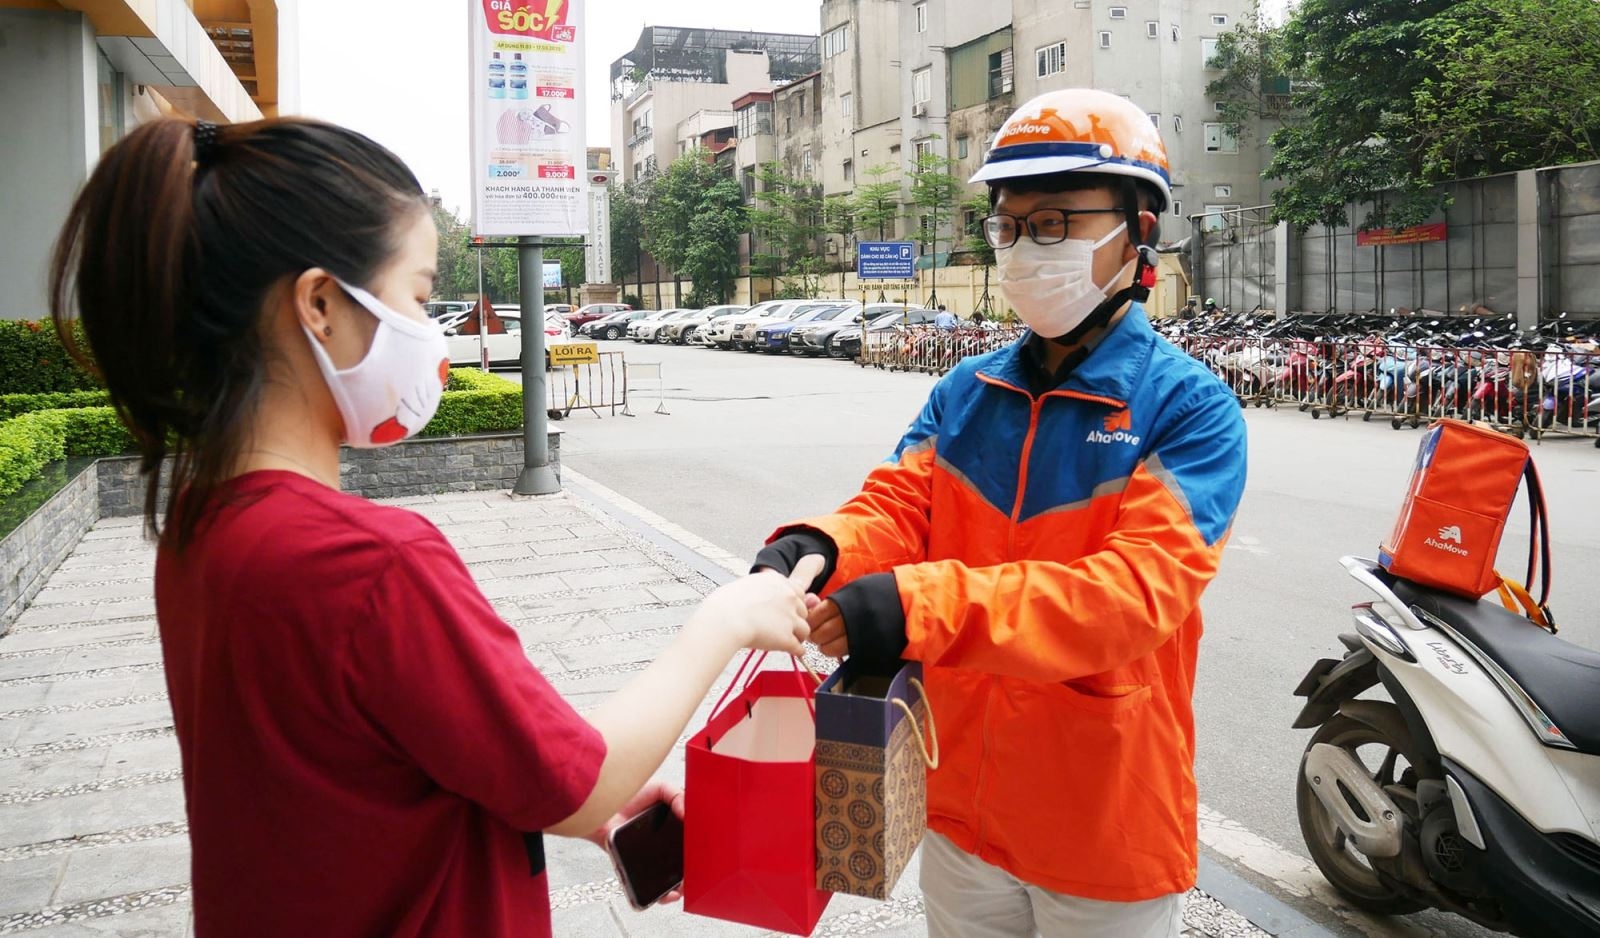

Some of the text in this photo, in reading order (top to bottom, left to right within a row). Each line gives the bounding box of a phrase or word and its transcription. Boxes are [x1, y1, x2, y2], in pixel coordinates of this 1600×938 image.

[490, 0, 512, 11] GIÁ
[497, 5, 544, 32] SỐC
[1002, 123, 1051, 137] haMove
[902, 248, 909, 257] P
[577, 347, 593, 355] RA
[1086, 430, 1140, 446] Ahaove
[1423, 537, 1469, 557] AhaMove
[1426, 642, 1469, 675] Liberty
